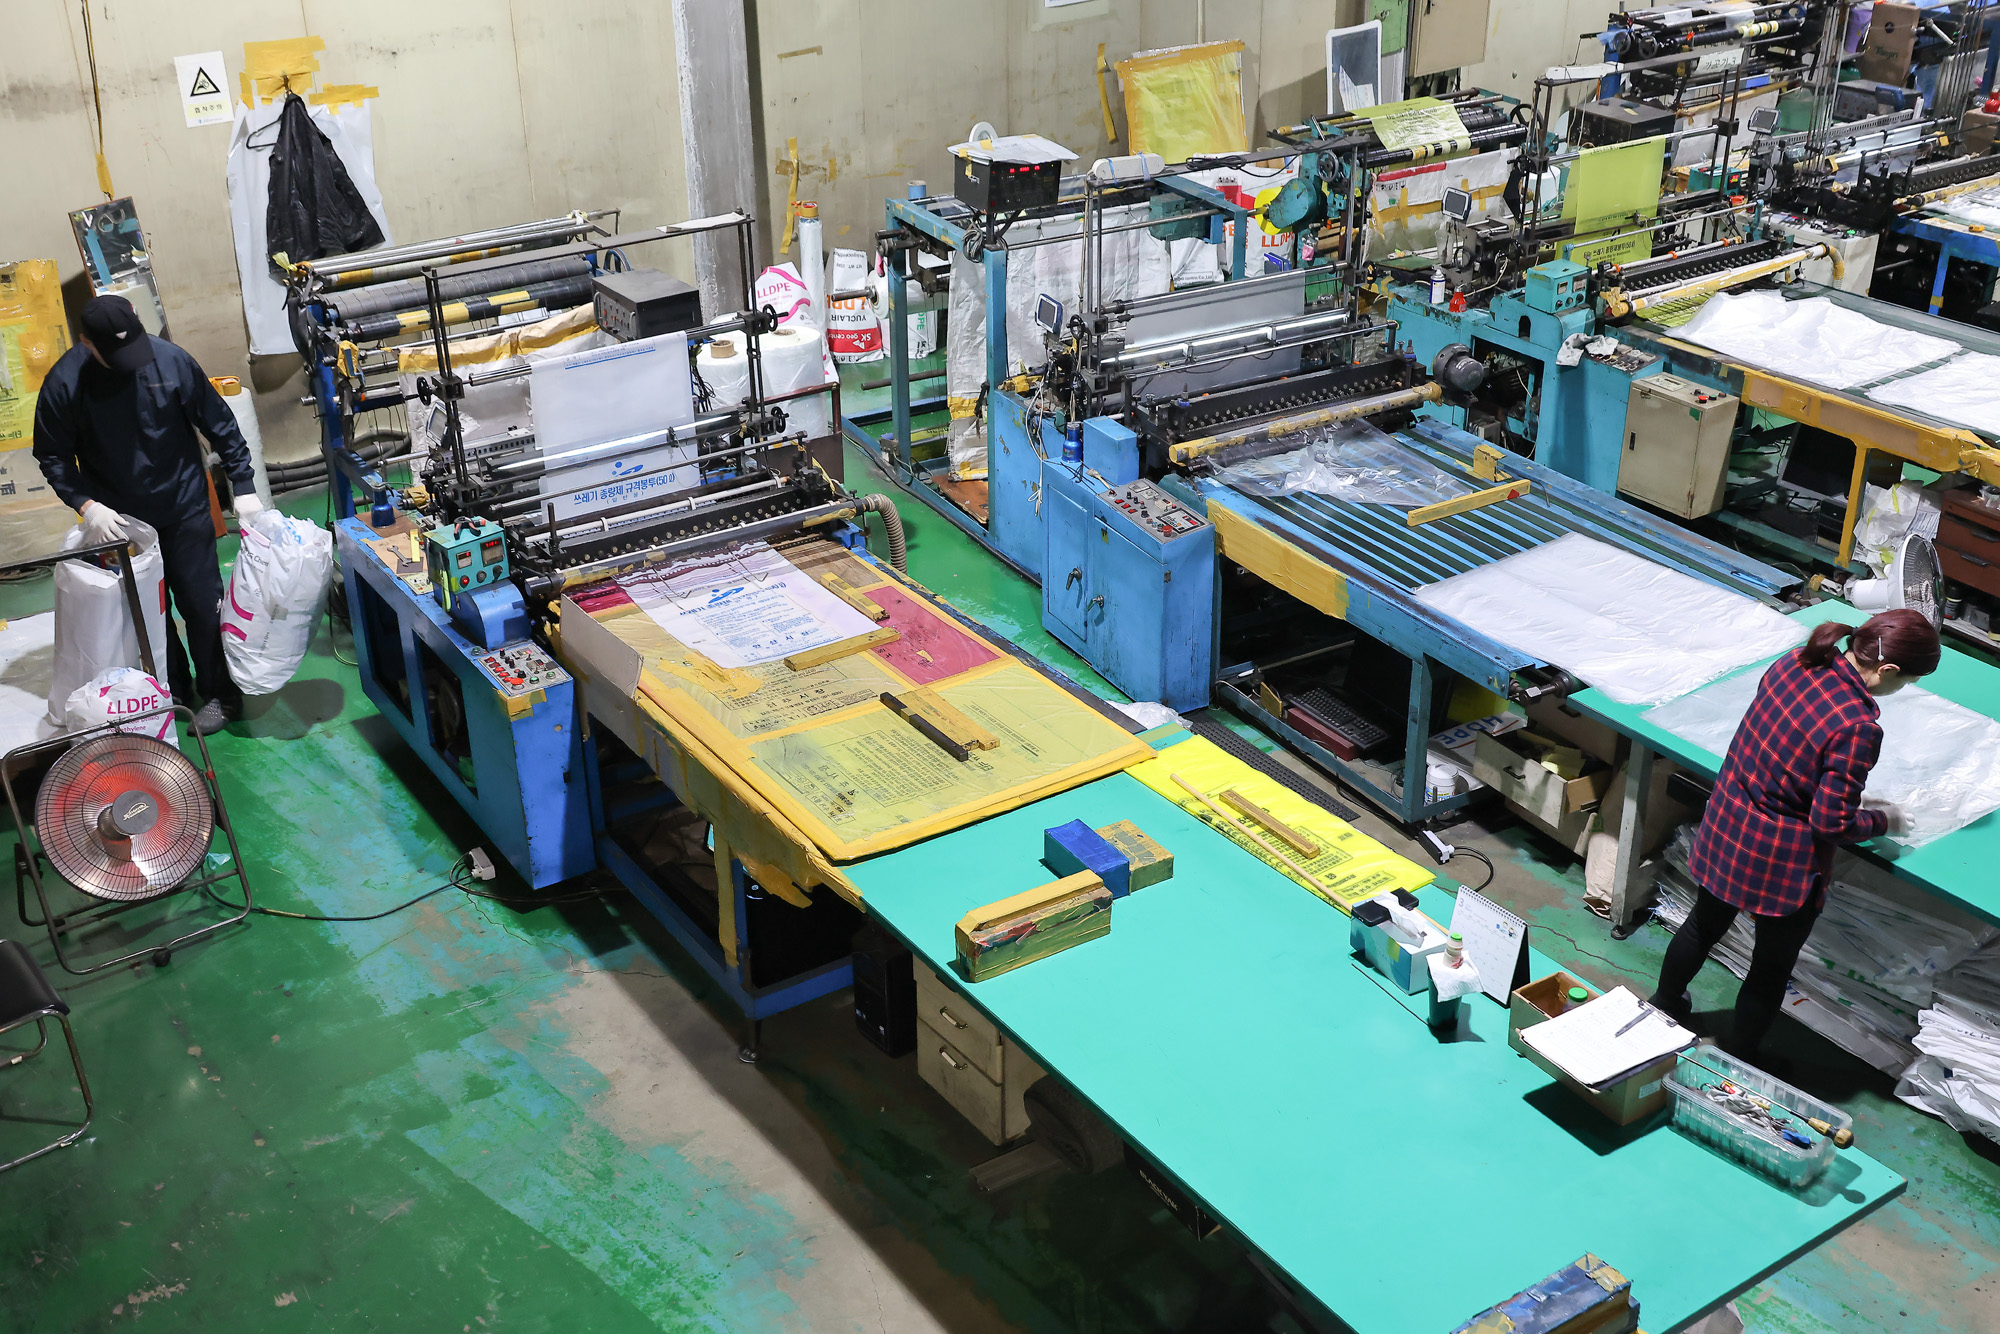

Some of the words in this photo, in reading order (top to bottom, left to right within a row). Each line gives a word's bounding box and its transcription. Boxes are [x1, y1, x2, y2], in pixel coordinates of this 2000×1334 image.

[757, 282, 791, 299] LLDPE
[830, 314, 867, 322] YUCLAIR
[846, 332, 859, 340] geo
[860, 333, 872, 341] SK
[573, 490, 599, 506] 쓰레기
[599, 484, 624, 500] 종량제
[107, 694, 159, 715] LLDPE
[1434, 715, 1503, 745] HDPE
[1458, 897, 1465, 908] 3
